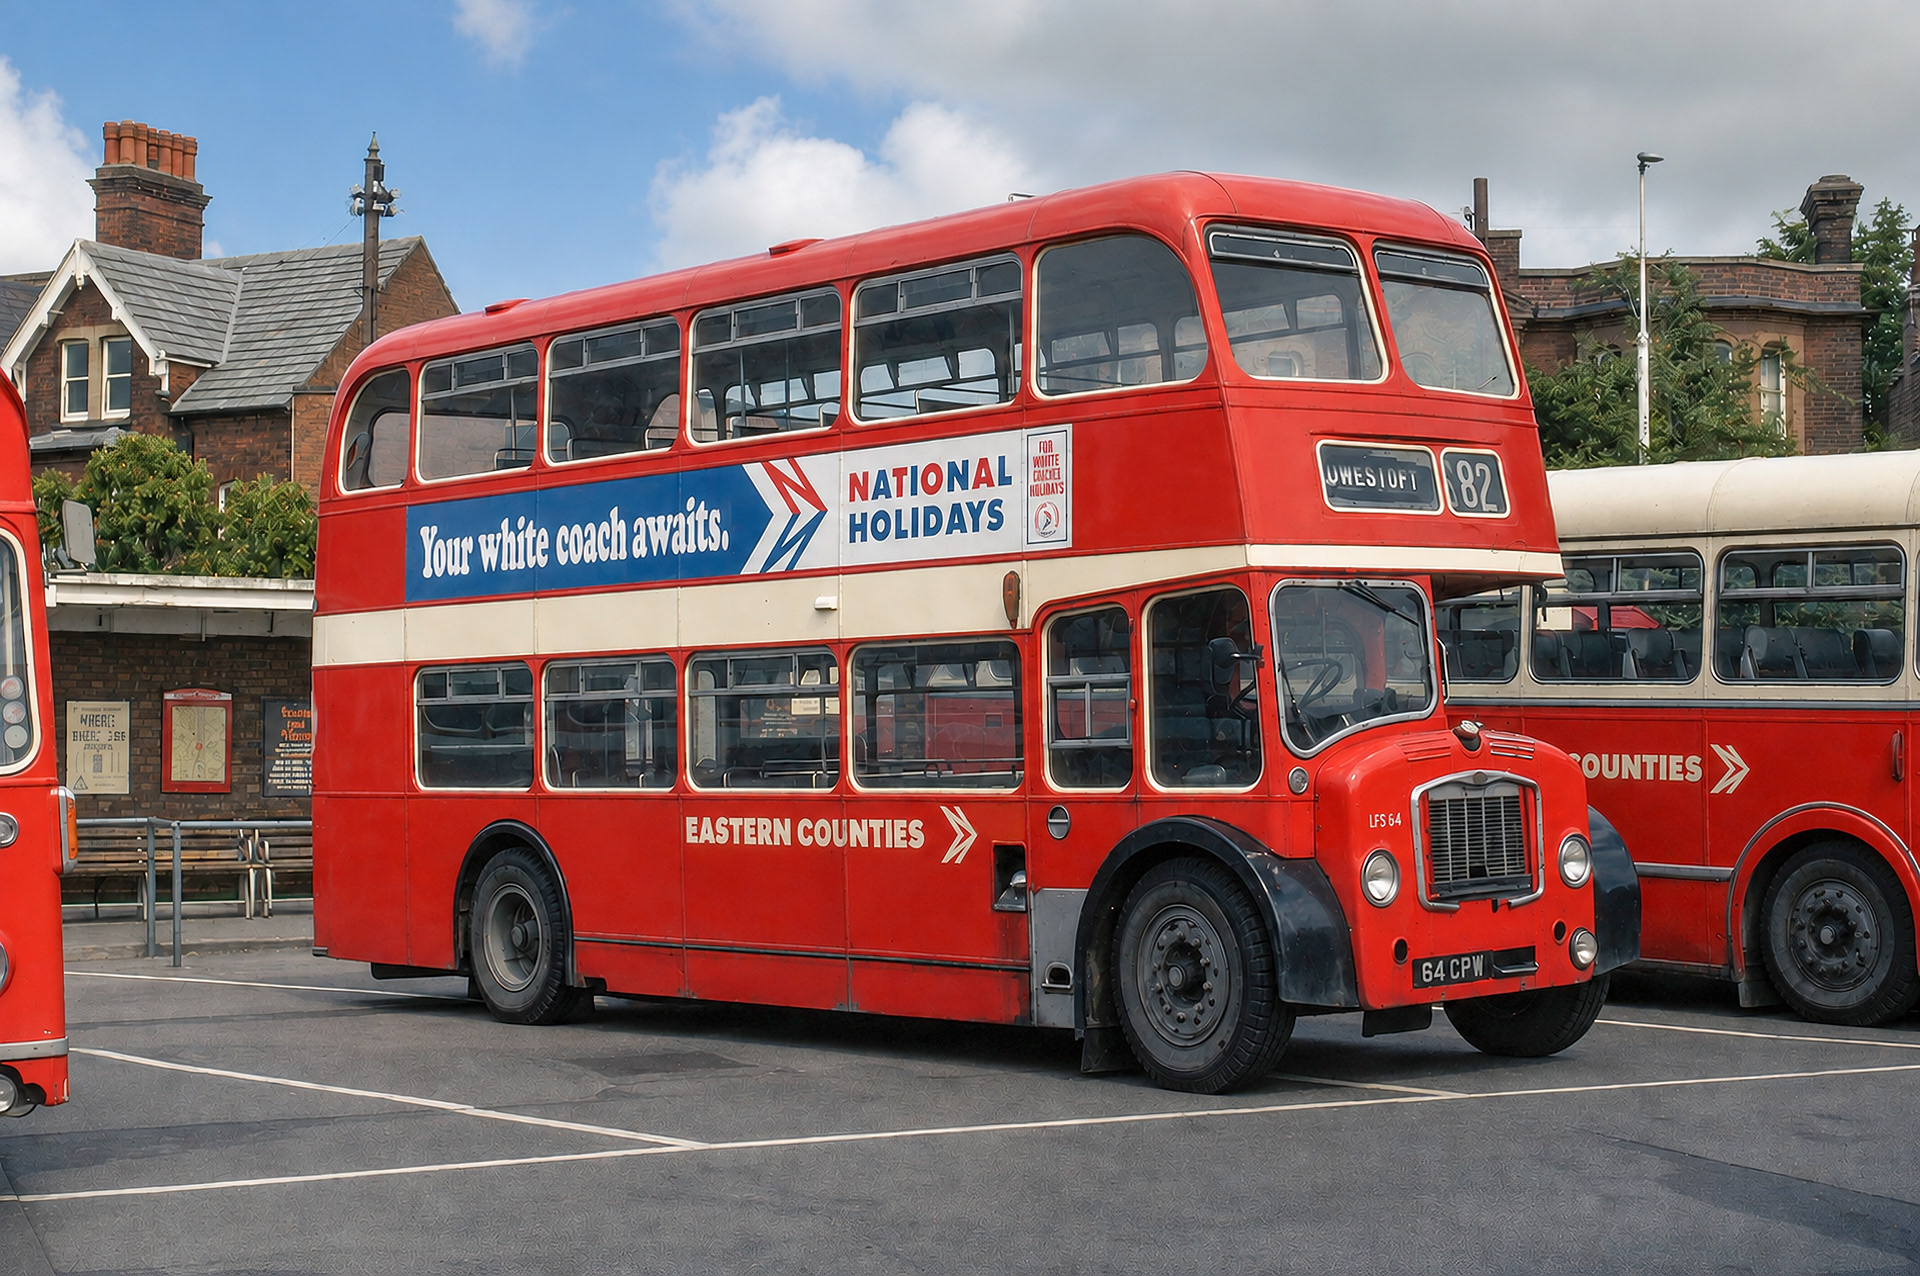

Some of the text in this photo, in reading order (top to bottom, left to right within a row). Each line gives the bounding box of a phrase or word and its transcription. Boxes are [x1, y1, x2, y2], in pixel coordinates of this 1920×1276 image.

[1033, 454, 1060, 468] WHITE
[1039, 440, 1054, 453] FOR
[849, 456, 1012, 502] NATIONAL
[1030, 481, 1065, 497] HOLIDAYS
[849, 499, 1005, 543] HOLIDAYS
[420, 496, 730, 578] Your white coach awaits.
[686, 816, 925, 848] EASTERN COUNTIES
[1369, 812, 1402, 828] LFS 64
[1422, 954, 1484, 983] 64 CPW
